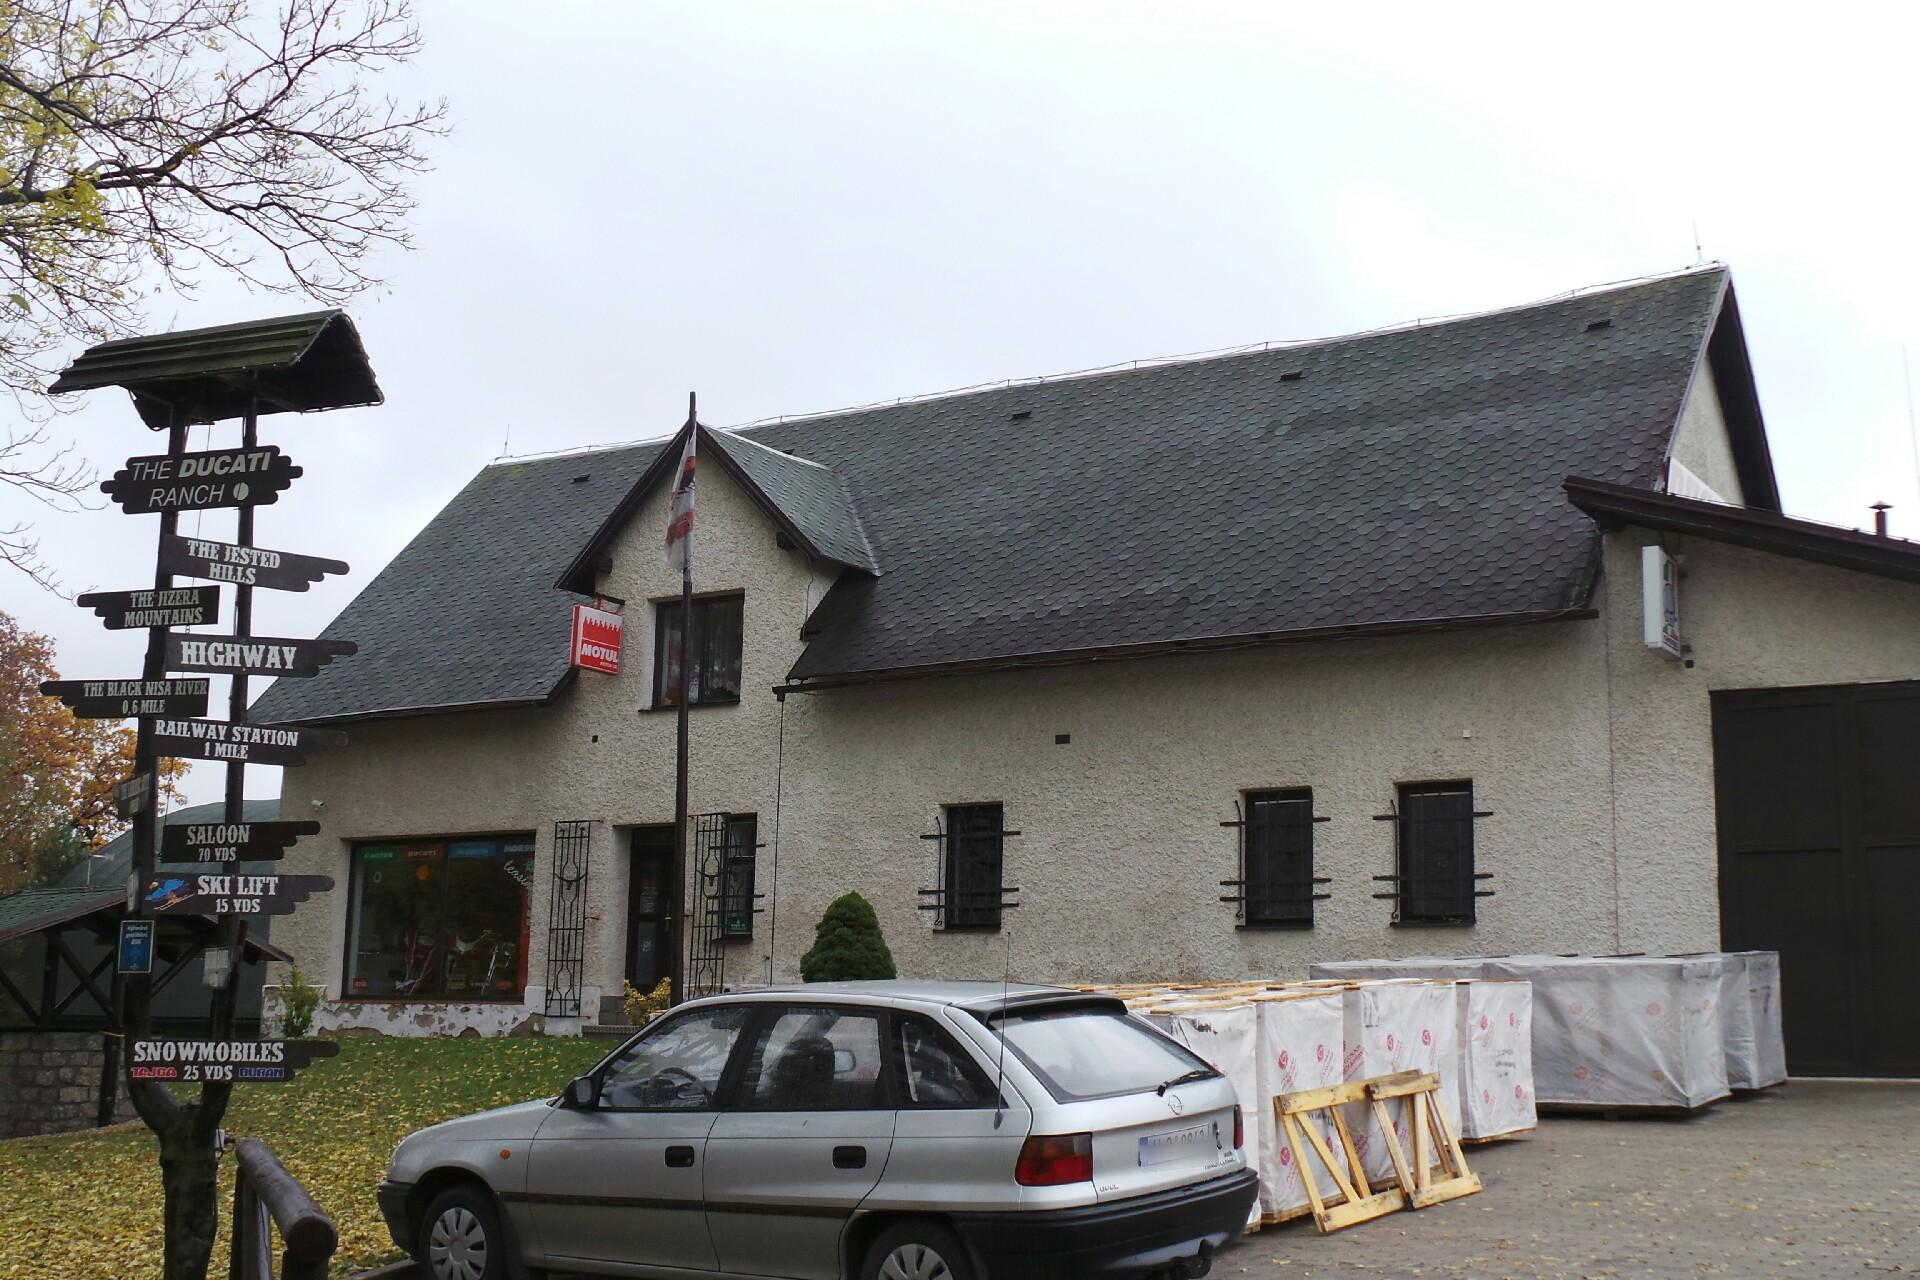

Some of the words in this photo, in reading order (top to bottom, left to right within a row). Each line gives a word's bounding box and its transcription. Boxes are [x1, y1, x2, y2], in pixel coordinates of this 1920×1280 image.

[132, 459, 174, 481] THE
[178, 452, 272, 478] DUCATI
[149, 484, 225, 507] RANCH
[188, 539, 220, 560] THE
[224, 544, 281, 569] JESTED
[209, 563, 256, 585] HILLS
[130, 591, 155, 608] THE
[158, 588, 200, 606] JIZERA
[124, 607, 203, 627] MOUNTAINS
[180, 641, 297, 670] HIGHWAY
[581, 643, 618, 662] MOTUL
[84, 682, 104, 697] THE
[107, 681, 142, 697] BLACK
[146, 680, 171, 696] NISA
[174, 679, 208, 695] RIVER
[140, 699, 165, 714] MILE
[155, 719, 227, 741] RAILWAY
[232, 727, 299, 747] STATION
[204, 742, 211, 757] 1
[214, 743, 249, 759] MILE
[186, 824, 250, 845] SALOON
[198, 848, 211, 862] 70
[215, 847, 236, 861] YDS
[197, 875, 230, 895] SKI
[235, 876, 279, 896] LIFT
[216, 899, 229, 913] 15
[233, 899, 261, 913] YDS
[134, 1041, 284, 1062] SNOWMOBILES
[183, 1065, 199, 1080] 25
[204, 1065, 233, 1080] YDS
